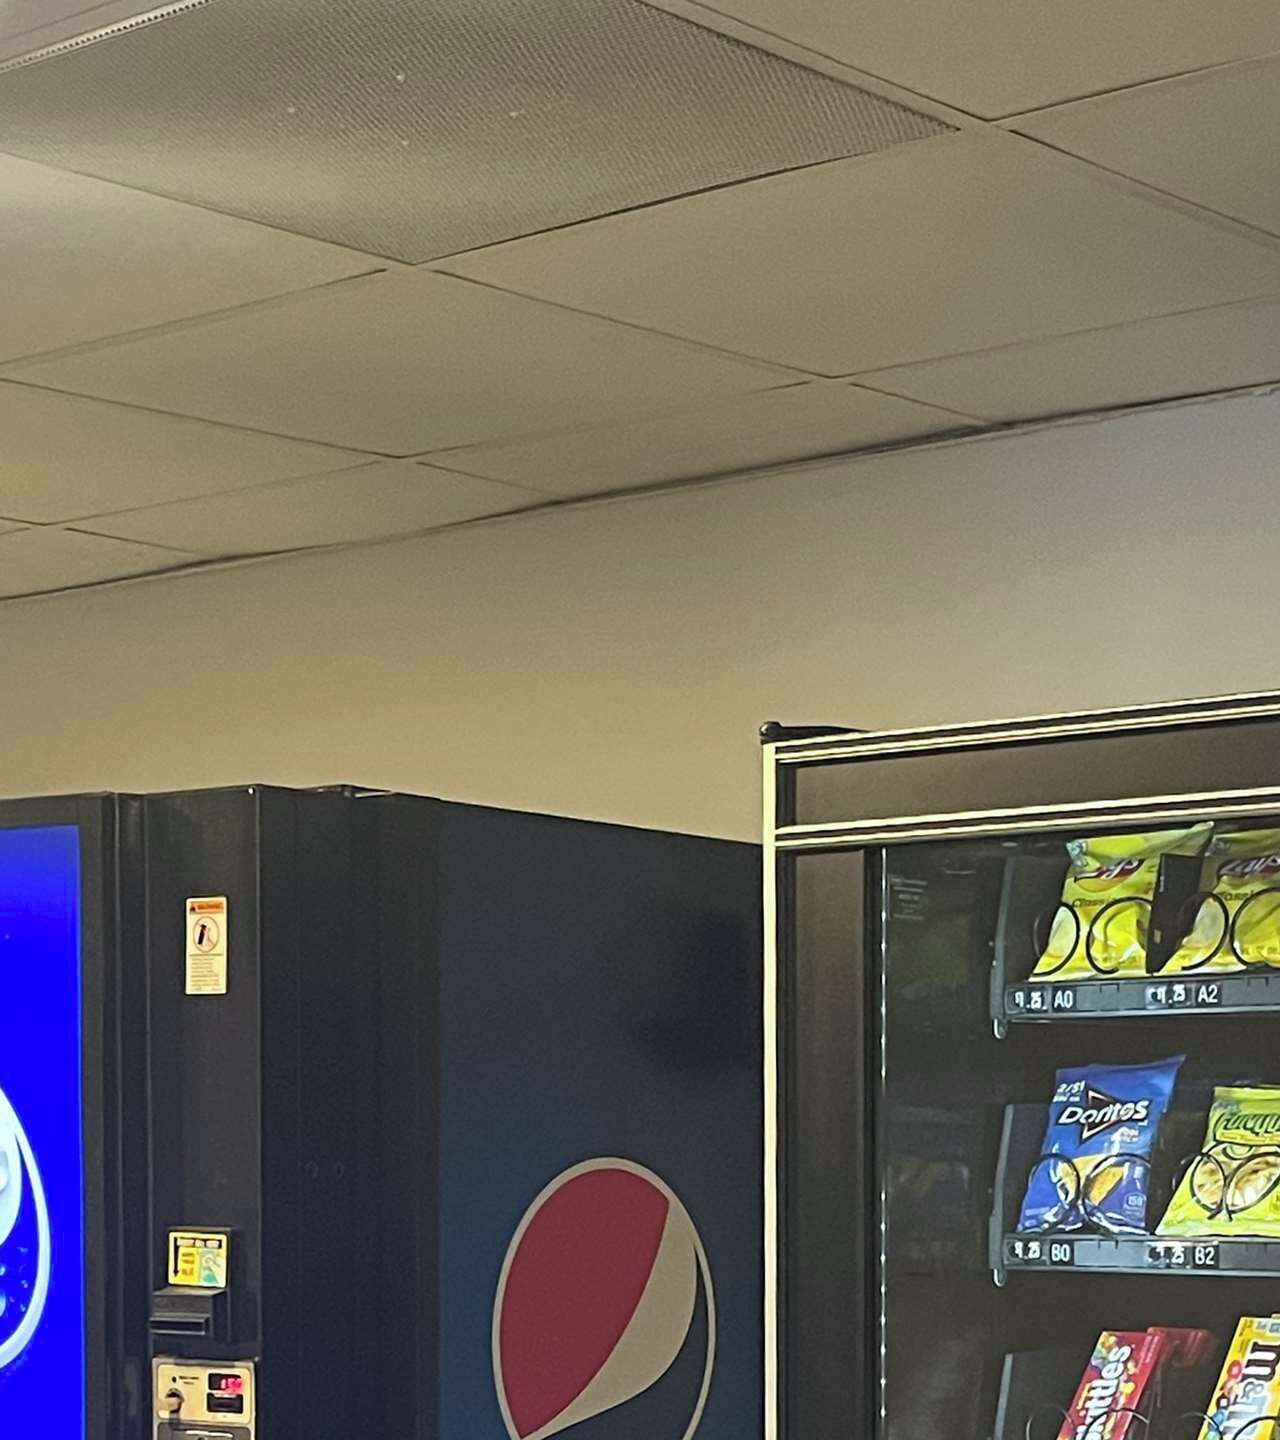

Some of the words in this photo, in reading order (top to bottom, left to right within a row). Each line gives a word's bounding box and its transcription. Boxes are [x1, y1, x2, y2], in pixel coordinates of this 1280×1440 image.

[1054, 990, 1073, 1007] A0
[1197, 985, 1219, 1003] A2
[1058, 1100, 1150, 1125] Doritos
[1195, 1248, 1215, 1265] B2
